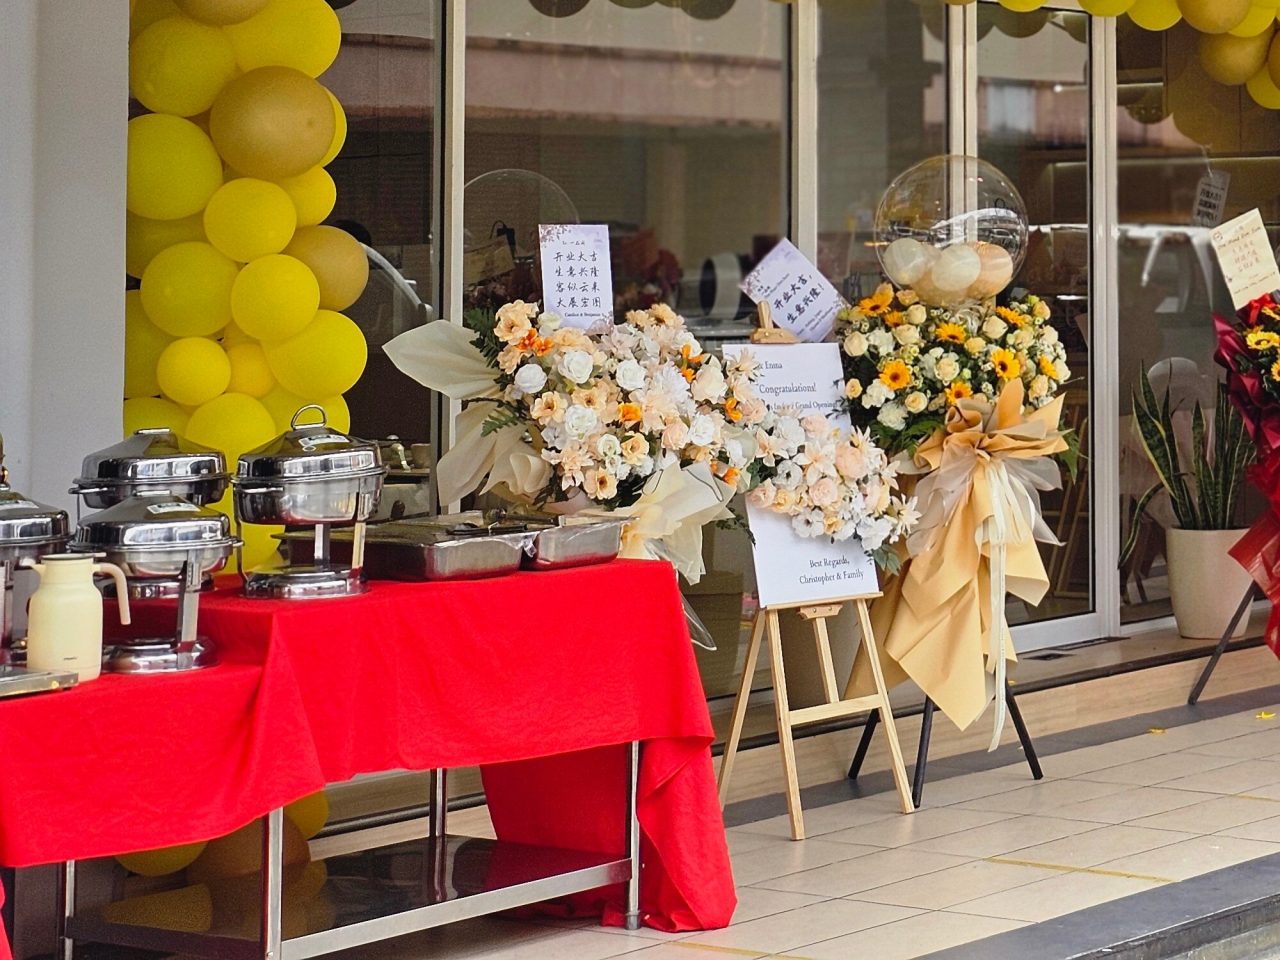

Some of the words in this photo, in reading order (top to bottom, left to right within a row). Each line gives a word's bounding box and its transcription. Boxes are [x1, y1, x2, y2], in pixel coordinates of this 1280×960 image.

[553, 251, 597, 262] 开业大吉
[555, 266, 600, 277] 生意兴隆
[556, 281, 600, 293] 客似云来
[759, 382, 817, 396] Congratulations!
[795, 401, 812, 410] Grand
[809, 559, 822, 568] Best
[823, 555, 850, 568] Regards,
[799, 572, 835, 585] Christopher
[843, 568, 864, 580] Family
